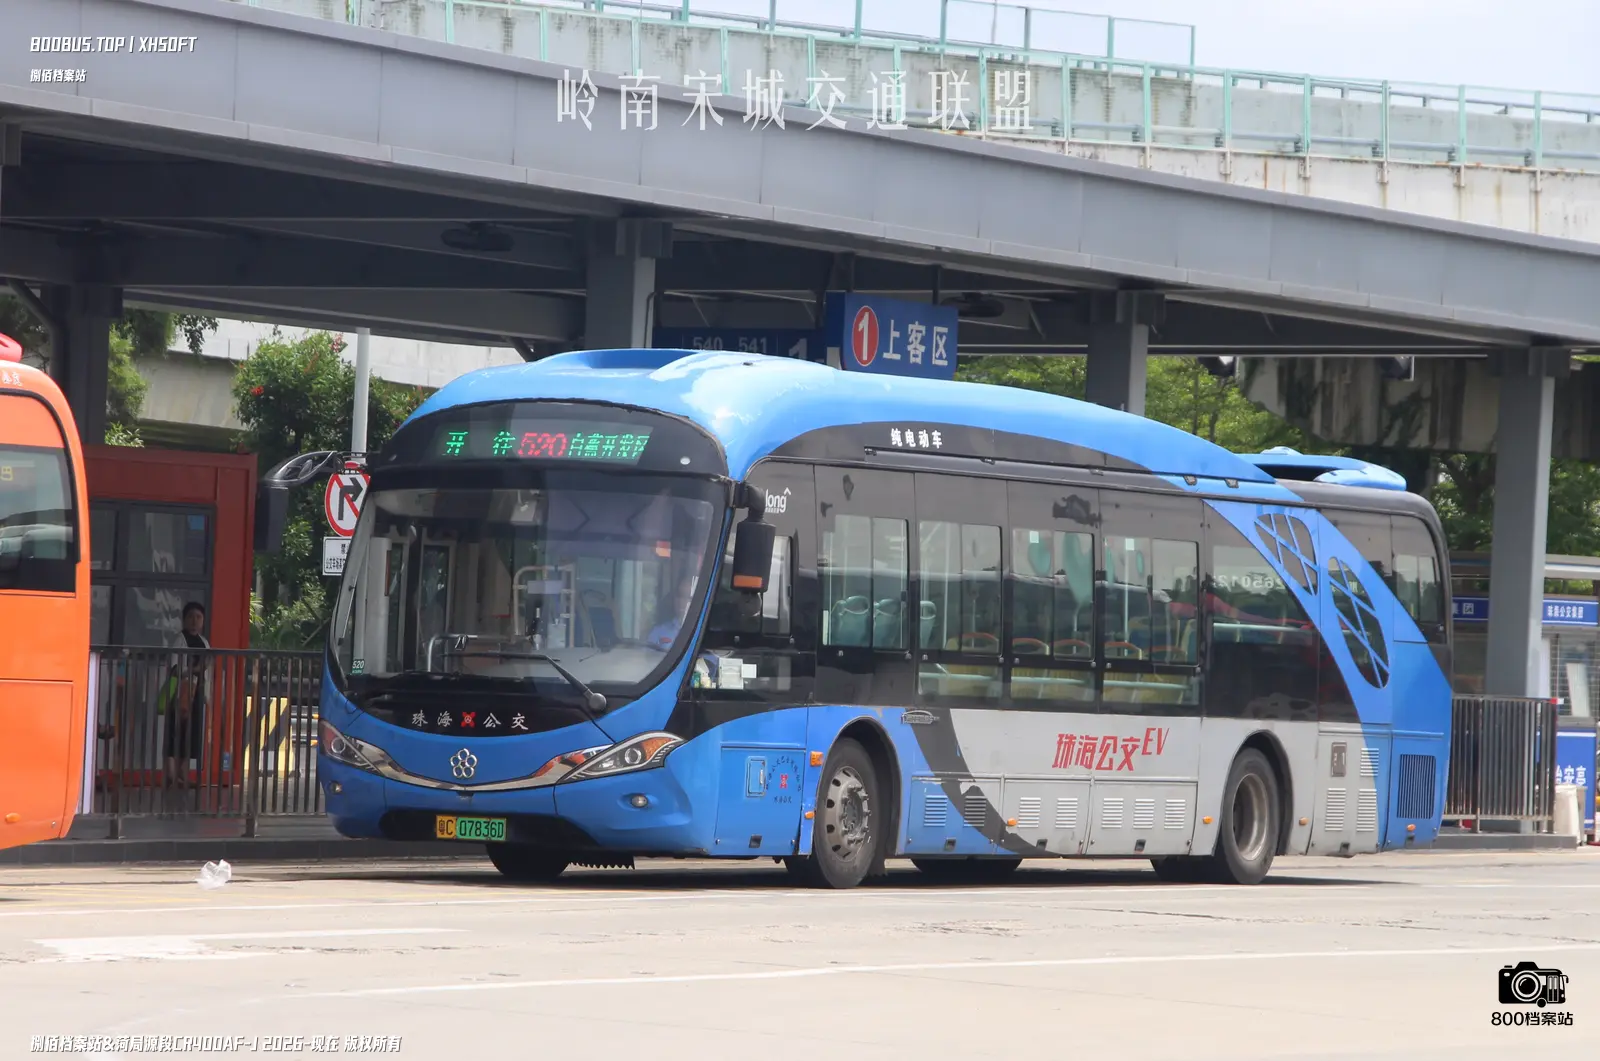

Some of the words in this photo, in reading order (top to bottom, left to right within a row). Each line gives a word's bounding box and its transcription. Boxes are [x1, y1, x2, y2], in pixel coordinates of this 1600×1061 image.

[693, 337, 723, 350] 540
[738, 337, 768, 353] 541
[882, 319, 949, 366] 上客区
[518, 432, 568, 457] 520
[890, 427, 943, 449] 纯电动车
[352, 660, 365, 669] 520
[412, 710, 452, 727] 珠海
[483, 712, 528, 730] 公交
[1052, 733, 1141, 771] 珠海公交
[1141, 727, 1170, 755] EV
[459, 820, 505, 838] 07836D
